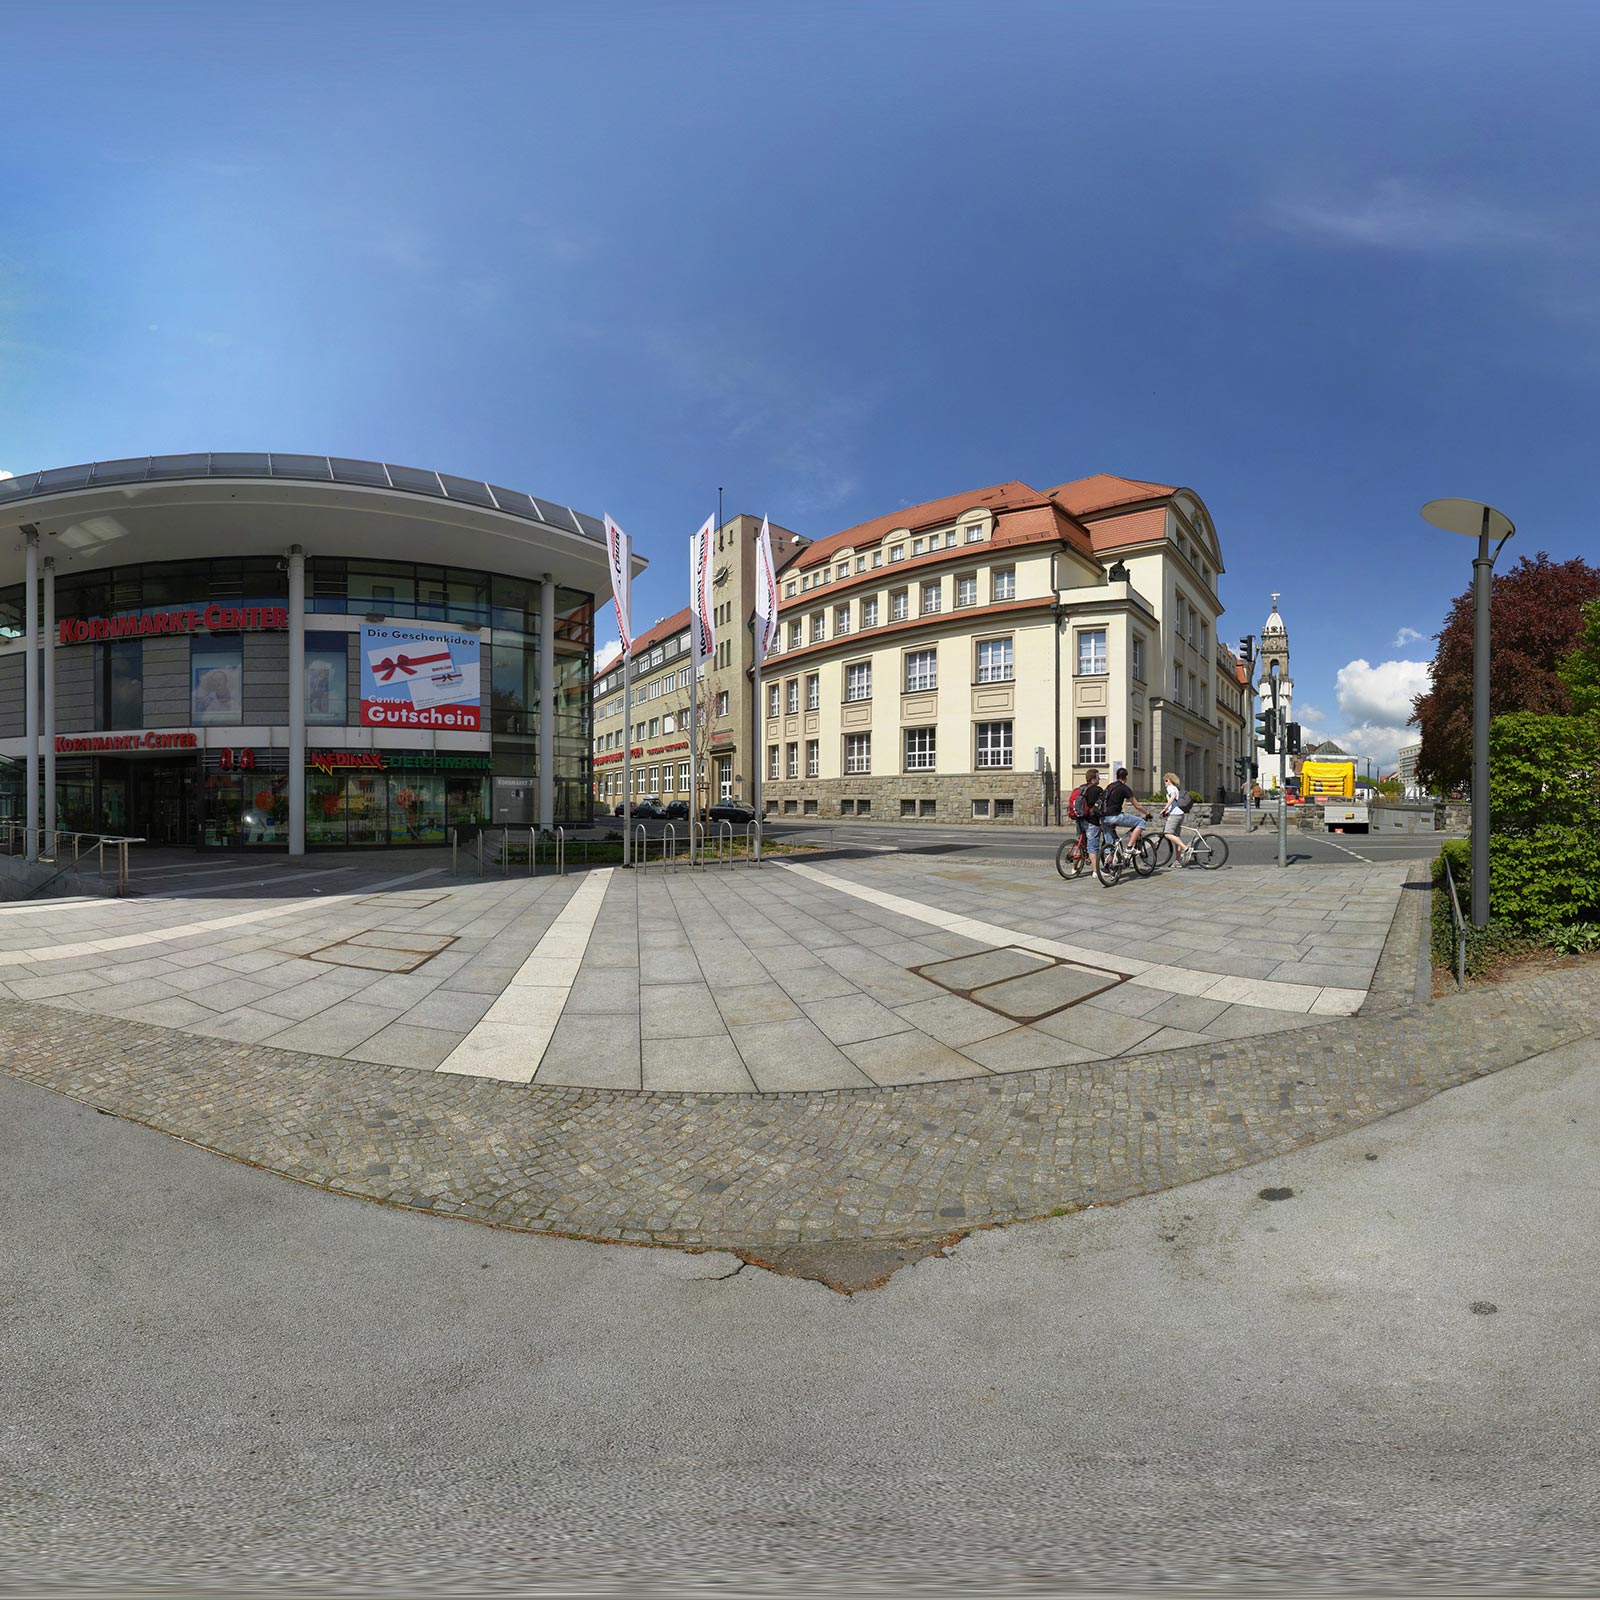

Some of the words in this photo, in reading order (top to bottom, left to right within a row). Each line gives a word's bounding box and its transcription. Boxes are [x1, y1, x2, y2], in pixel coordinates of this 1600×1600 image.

[59, 604, 288, 643] KORNMARKT-CENTER
[367, 629, 388, 638] Die
[391, 630, 475, 646] Geschenkidee
[368, 695, 411, 704] Center-
[367, 706, 475, 726] Gutschein
[55, 731, 197, 752] KORNMARKT-CENTER
[311, 751, 385, 770] MEDIMAX
[389, 755, 494, 769] DEICHMANN
